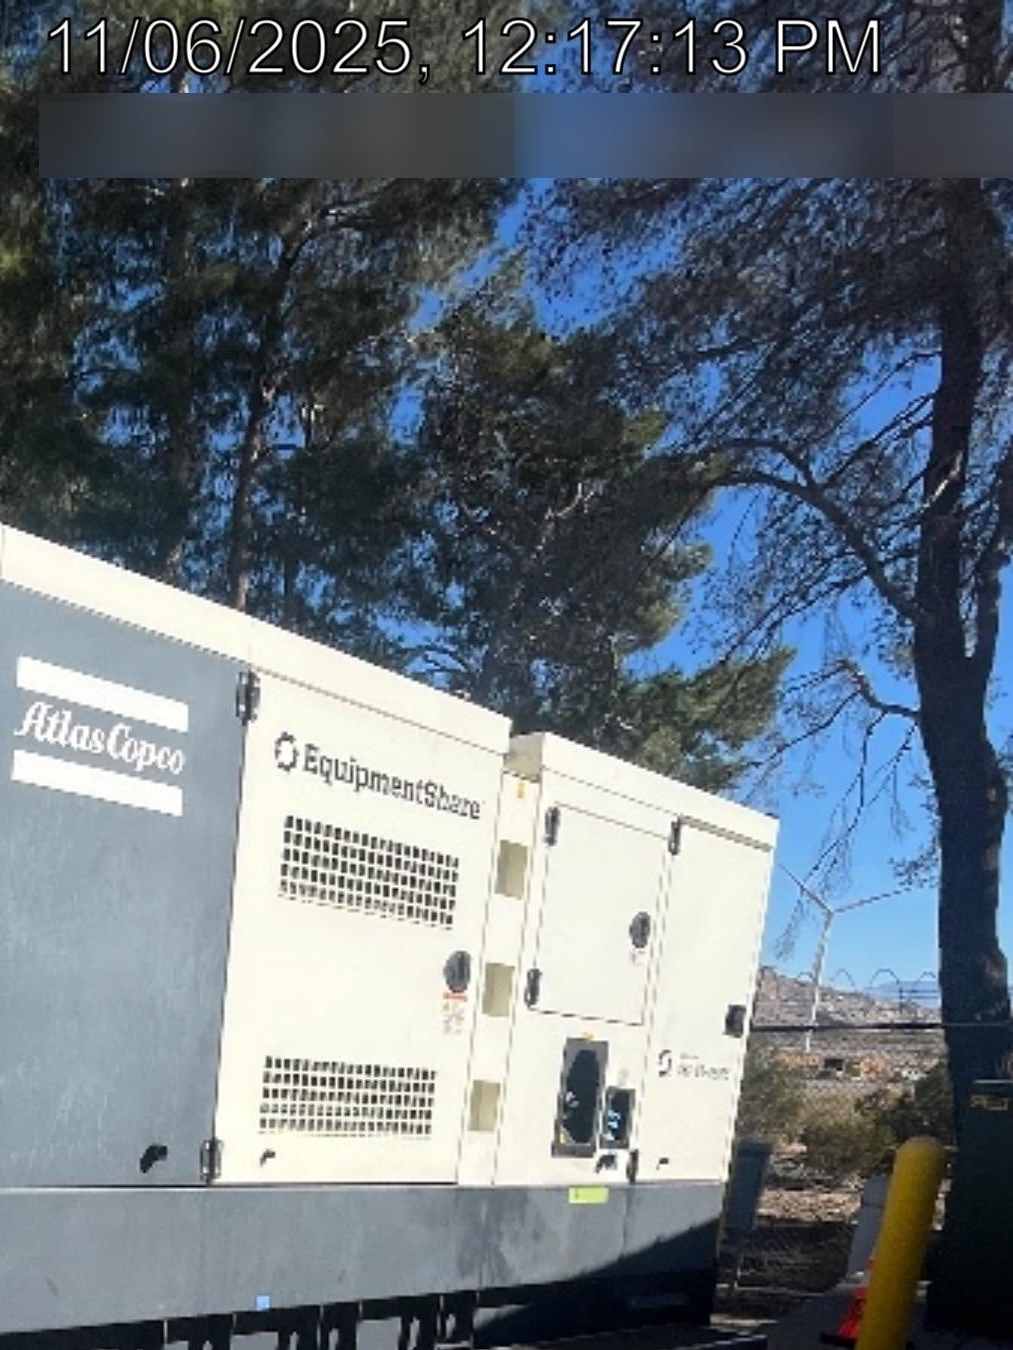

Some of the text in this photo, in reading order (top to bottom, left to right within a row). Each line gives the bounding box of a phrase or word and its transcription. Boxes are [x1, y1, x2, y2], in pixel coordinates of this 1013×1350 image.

[13, 701, 186, 775] Atlas Copco
[303, 743, 481, 820] EquipmentShare
